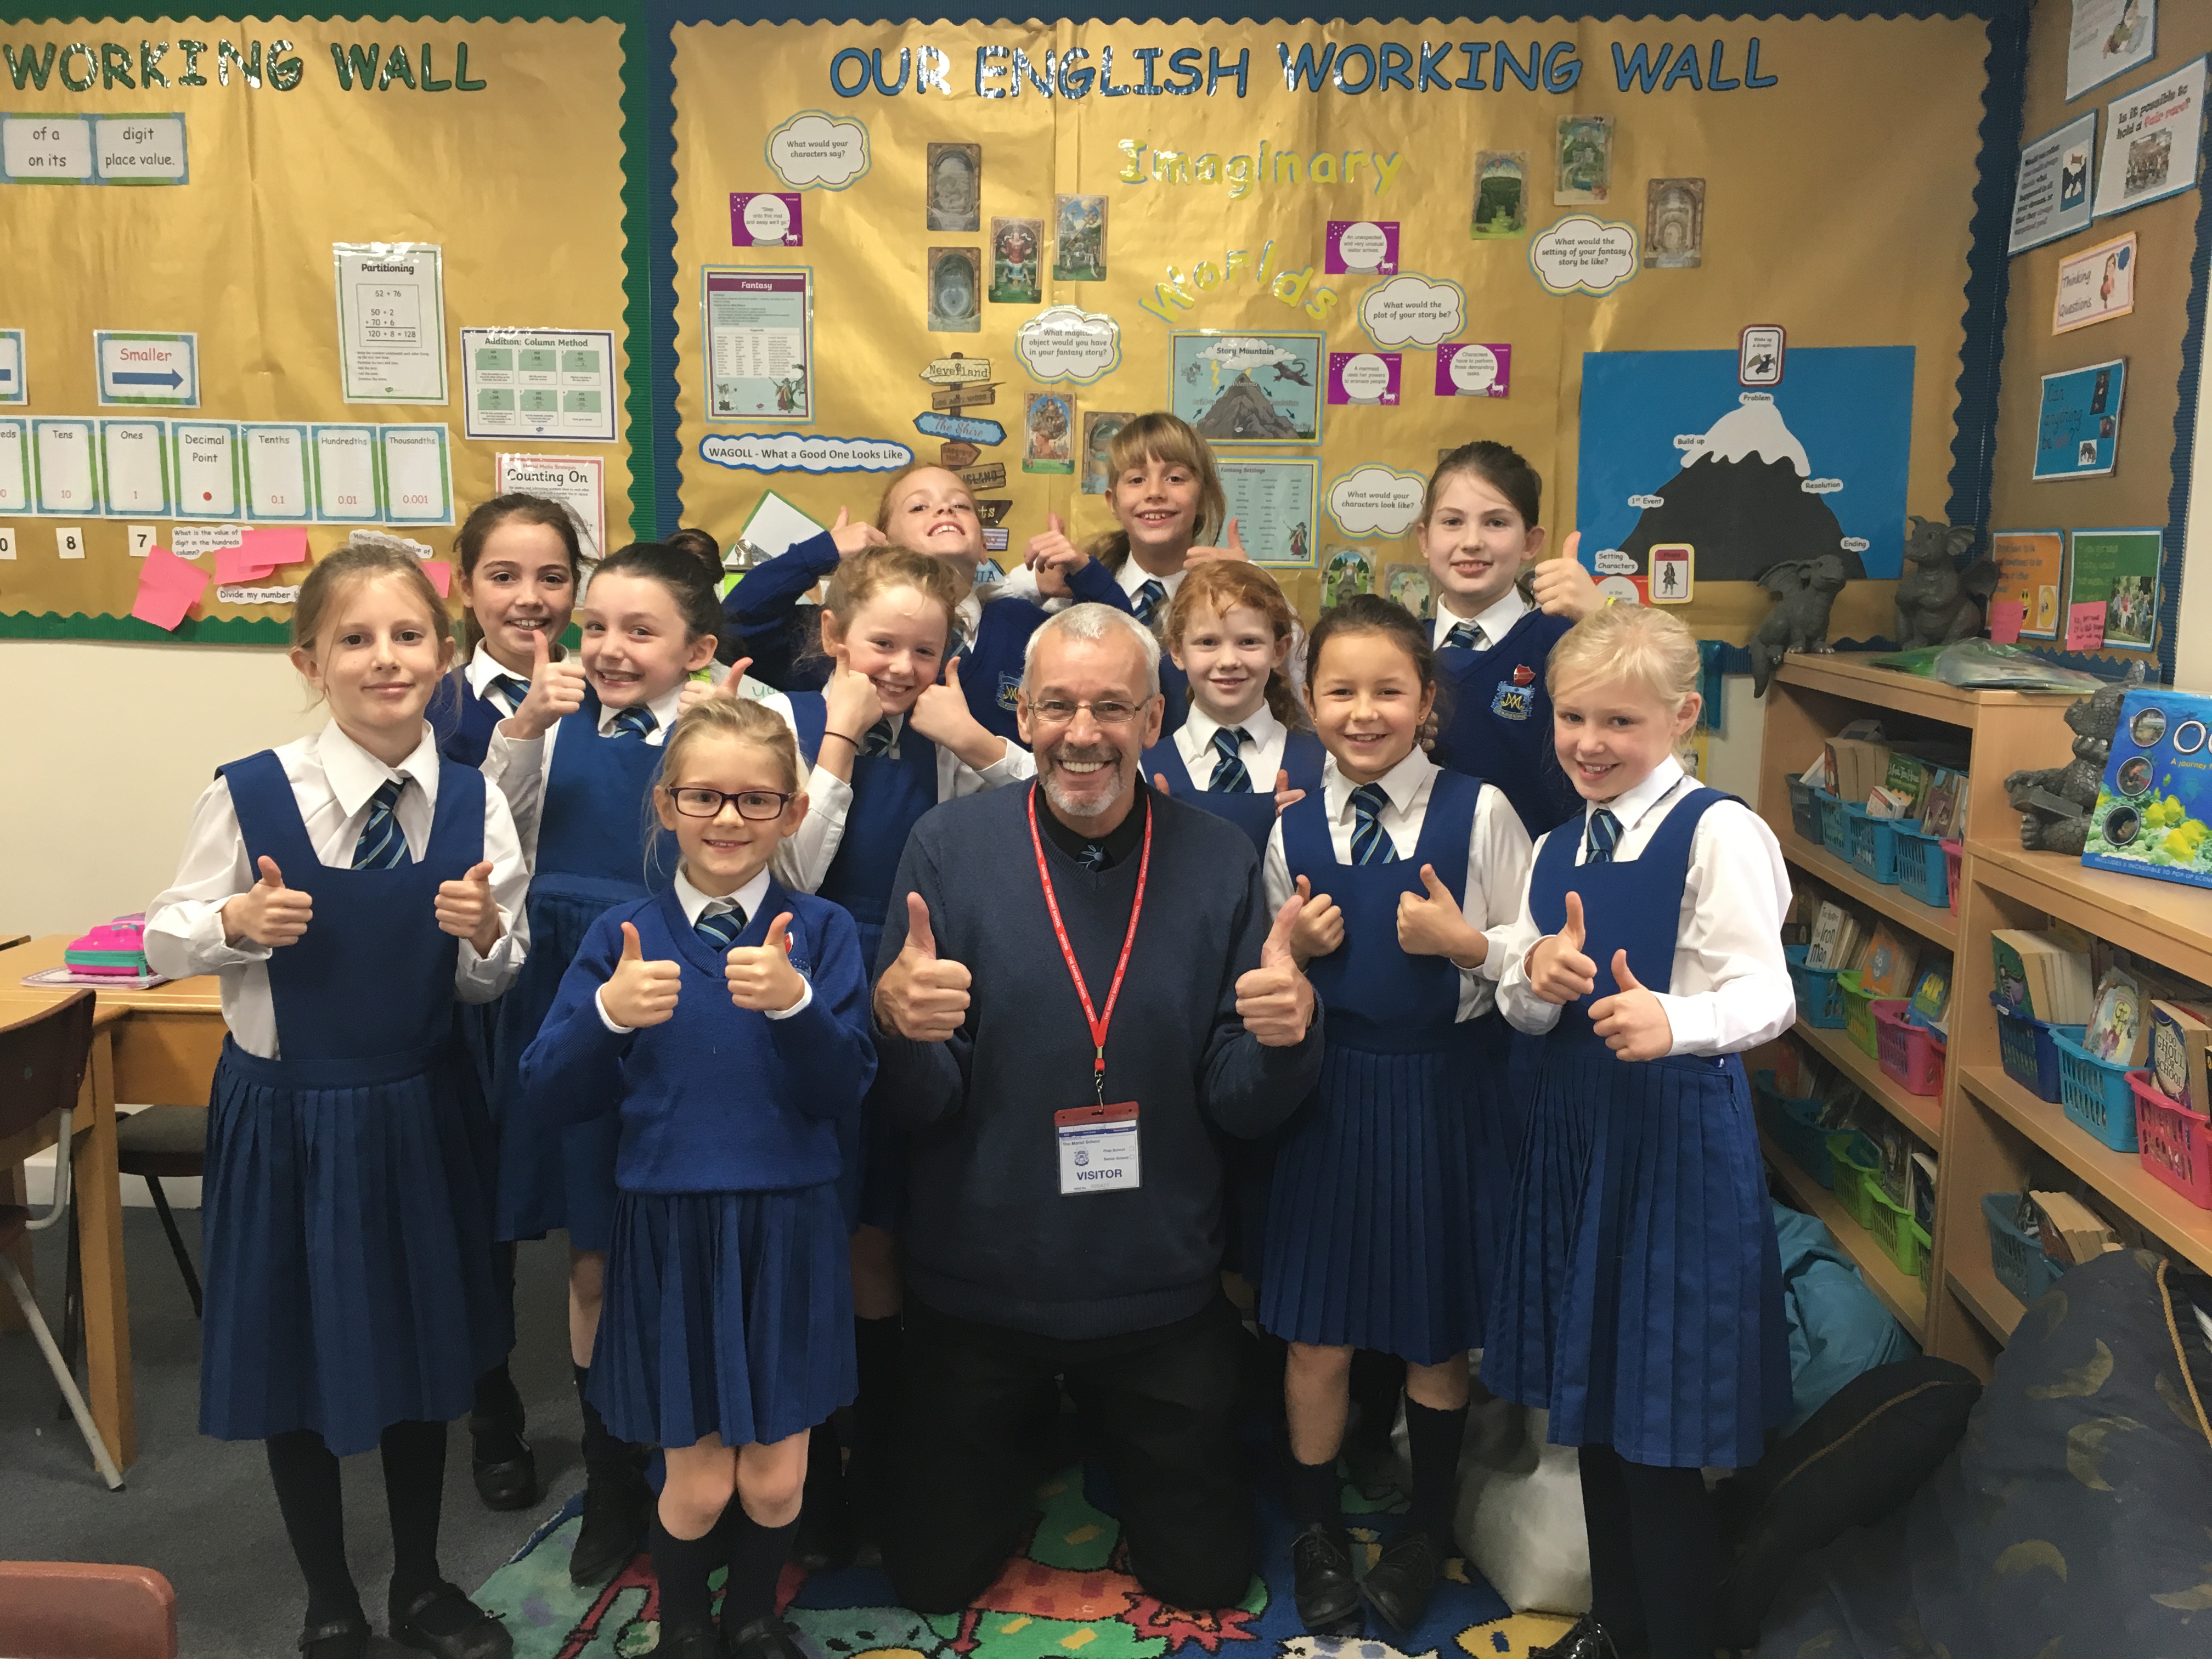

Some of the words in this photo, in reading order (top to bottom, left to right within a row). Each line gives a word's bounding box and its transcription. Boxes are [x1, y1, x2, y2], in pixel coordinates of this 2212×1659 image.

[3, 40, 303, 93] WORKING
[331, 41, 487, 93] WALL
[830, 45, 951, 97] OUR
[975, 45, 1249, 99] ENGLISH
[1277, 40, 1582, 94] WORKING
[1611, 37, 1778, 93] WALL
[32, 127, 48, 142] of
[51, 130, 61, 142] a
[122, 127, 154, 144] digit
[29, 156, 43, 167] on
[47, 153, 67, 167] its
[105, 153, 136, 170] place
[139, 153, 176, 167] value.
[1118, 139, 1403, 200] Imaginary
[1542, 248, 1567, 256] setting
[1570, 248, 1577, 256] of
[1598, 247, 1626, 256] fantasy
[362, 263, 414, 275] Partitioning
[1138, 240, 1338, 324] Worlds
[2062, 268, 2091, 288] Thinking
[742, 281, 772, 290] Fantasy
[2059, 297, 2092, 318] Questions
[1390, 311, 1398, 319] of
[1399, 313, 1415, 321] your
[120, 348, 171, 362] Smaller
[1217, 347, 1236, 357] Story
[929, 365, 988, 377] Neverland
[934, 416, 952, 431] The
[956, 421, 983, 437] Shire
[2044, 407, 2083, 435] anything
[52, 429, 72, 439] Tens
[121, 430, 143, 441] Ones
[185, 434, 224, 445] Decimal
[258, 434, 290, 445] Tenths
[389, 437, 436, 445] Thousandths
[321, 437, 367, 447] Hundredths
[193, 452, 218, 463] Point
[709, 448, 753, 457] WAGOLL
[761, 449, 788, 459] What
[800, 450, 826, 459] Good
[830, 450, 849, 459] One
[853, 450, 880, 459] Looks
[884, 450, 902, 459] Like
[507, 469, 563, 486] Counting
[569, 471, 588, 483] On
[61, 490, 71, 499] 10
[133, 490, 138, 500] 1
[271, 495, 285, 505] 0.1
[338, 495, 358, 505] 0.01
[403, 495, 428, 505] 0.001
[66, 537, 76, 551] 8
[137, 534, 147, 548] 7
[2178, 761, 2207, 770] journey
[2095, 856, 2121, 866] INCLUDES
[2128, 863, 2161, 873] INCREDIBLE
[2172, 871, 2193, 879] POP-UP
[1820, 922, 1835, 945] Iron
[1810, 943, 1826, 964] man
[1052, 910, 1060, 928] SCHOOL
[1059, 933, 1069, 951] VISITOR
[1071, 964, 1080, 981] MARIST
[1077, 981, 1086, 1000] SCHOOL
[1086, 1004, 1095, 1023] VISITOR
[1107, 994, 1115, 1011] MARIST
[1112, 976, 1121, 994] SCHOOL
[1119, 953, 1127, 970] VISITOR
[2165, 1029, 2176, 1047] TOO
[2157, 1034, 2184, 1070] GHOUL
[2164, 1053, 2175, 1069] FOR
[2156, 1057, 2182, 1088] SCHOOL
[1076, 1169, 1122, 1180] VISITOR
